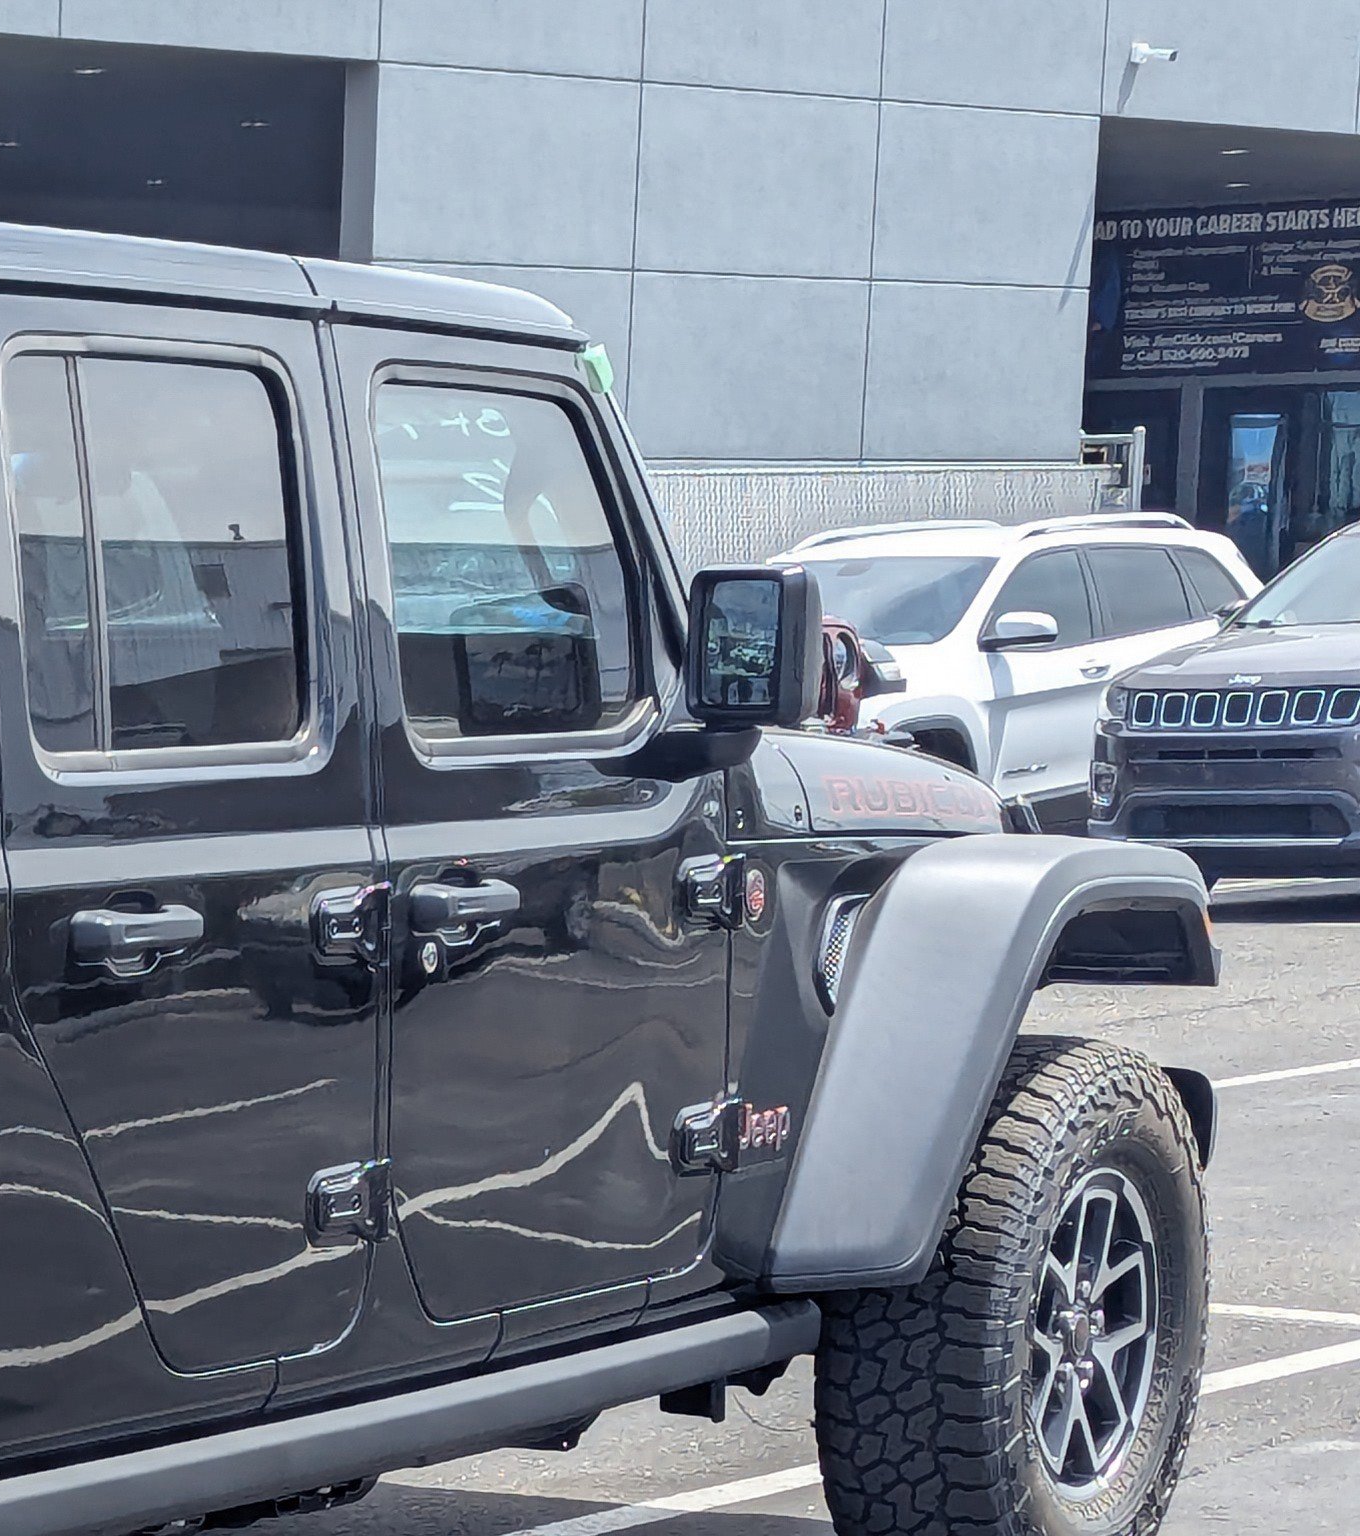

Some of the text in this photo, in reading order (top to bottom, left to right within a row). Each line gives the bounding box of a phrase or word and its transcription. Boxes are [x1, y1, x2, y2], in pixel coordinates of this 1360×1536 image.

[1121, 220, 1142, 239] TO
[1146, 216, 1192, 238] YOUR
[1197, 212, 1263, 234] CAREER
[1266, 209, 1329, 232] STARTS
[1124, 335, 1150, 348] Visit
[1137, 349, 1160, 362] Call
[739, 1102, 791, 1151] Jeep
